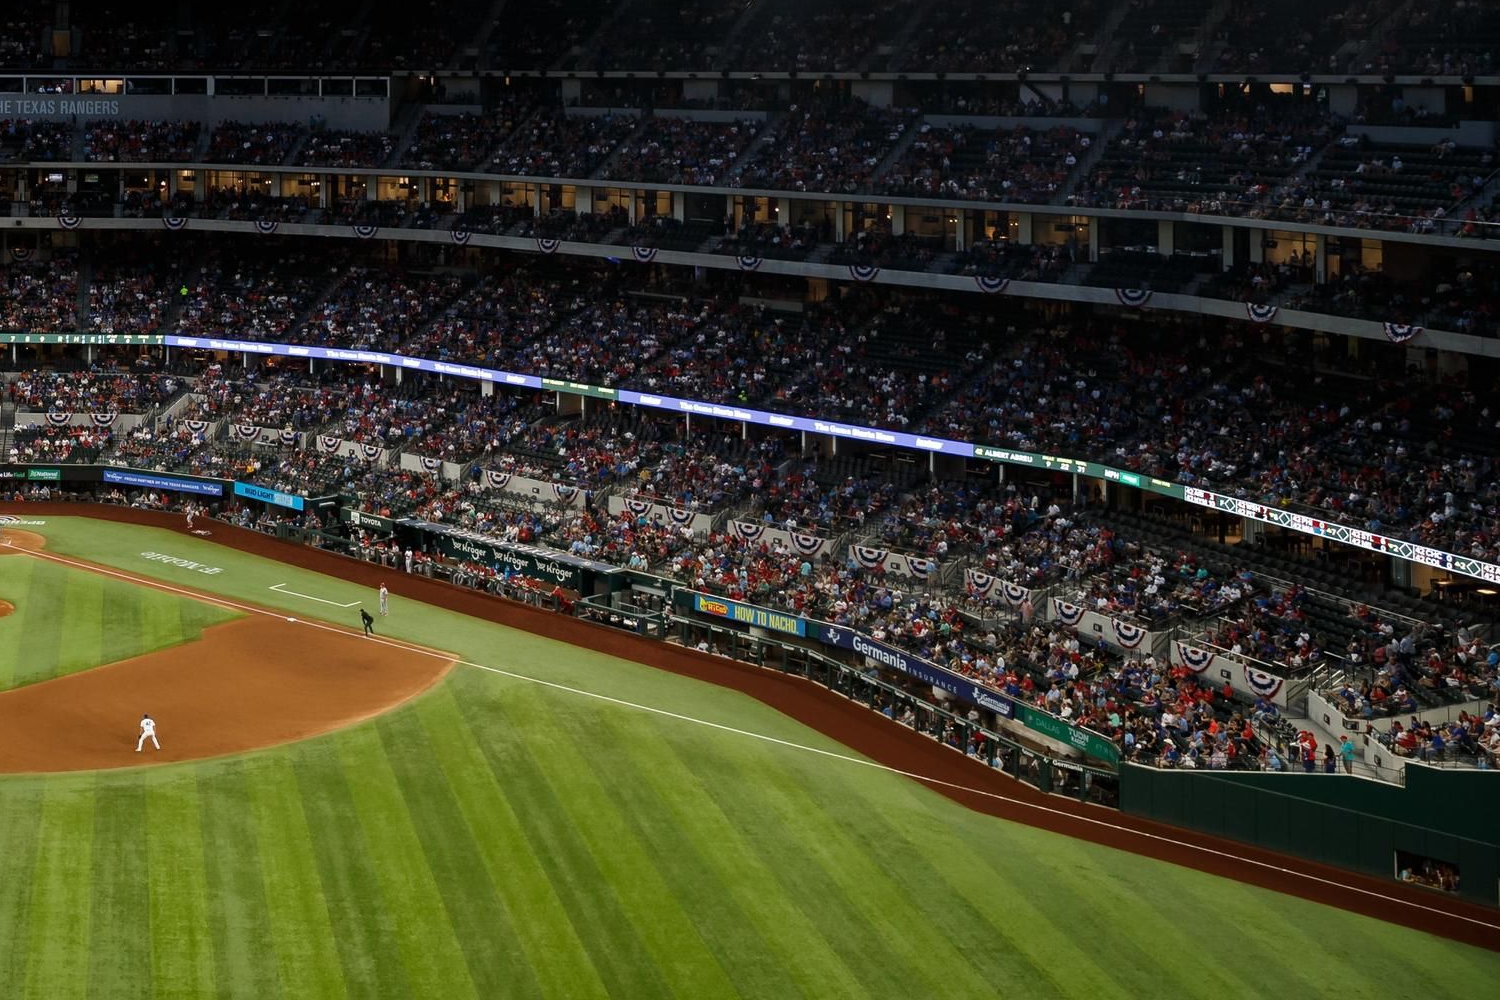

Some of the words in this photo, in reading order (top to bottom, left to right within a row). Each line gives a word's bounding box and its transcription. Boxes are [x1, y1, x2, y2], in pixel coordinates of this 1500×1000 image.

[16, 100, 55, 114] TEXAS
[60, 100, 119, 115] RANGERS
[984, 449, 1009, 459] ALBERT
[1009, 453, 1033, 463] ABREU
[1104, 469, 1119, 479] MPH
[244, 487, 257, 496] BUD
[257, 489, 274, 500] LIGHT
[361, 516, 381, 527] TOYOTA
[1361, 532, 1374, 542] STL
[462, 541, 486, 560] Kroger
[1415, 547, 1425, 555] 42
[1425, 550, 1442, 560] CHC
[504, 551, 529, 571] Kroger
[1415, 554, 1425, 563] 42
[1425, 556, 1440, 567] COL
[547, 561, 573, 582] Kroger
[1484, 565, 1494, 573] 42
[1484, 573, 1494, 581] 42
[734, 605, 754, 622] HOW
[756, 610, 767, 626] TO
[769, 614, 799, 634] NACHO.
[852, 635, 907, 672] Germania
[908, 667, 958, 695] INSURANCE
[982, 693, 1010, 713] Germania
[1035, 717, 1060, 736] DALLAS
[1052, 759, 1084, 772] Germania
